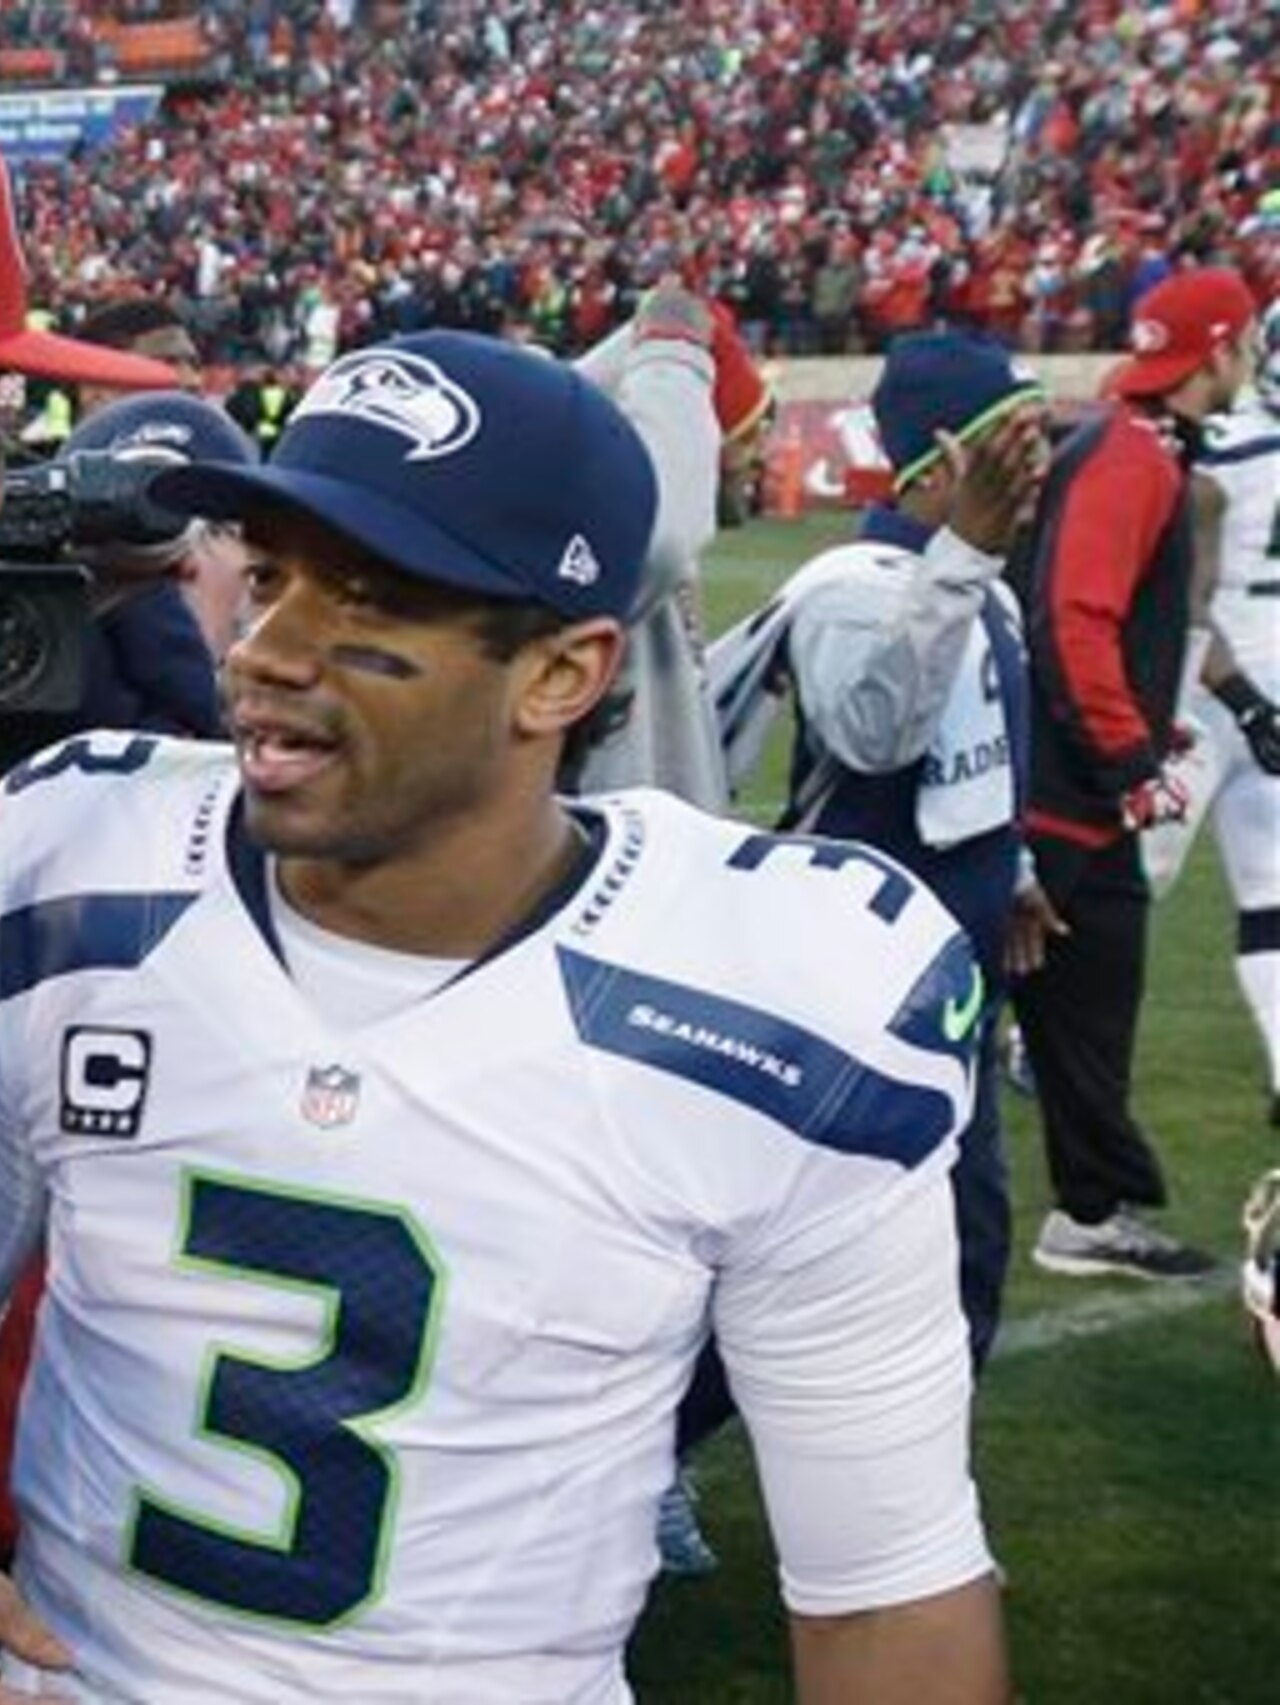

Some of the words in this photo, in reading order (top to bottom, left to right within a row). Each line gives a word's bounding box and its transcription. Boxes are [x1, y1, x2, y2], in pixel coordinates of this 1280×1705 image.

[68, 1029, 146, 1110] C
[626, 1003, 804, 1090] SEAHAWKS
[124, 1164, 450, 1638] 3
